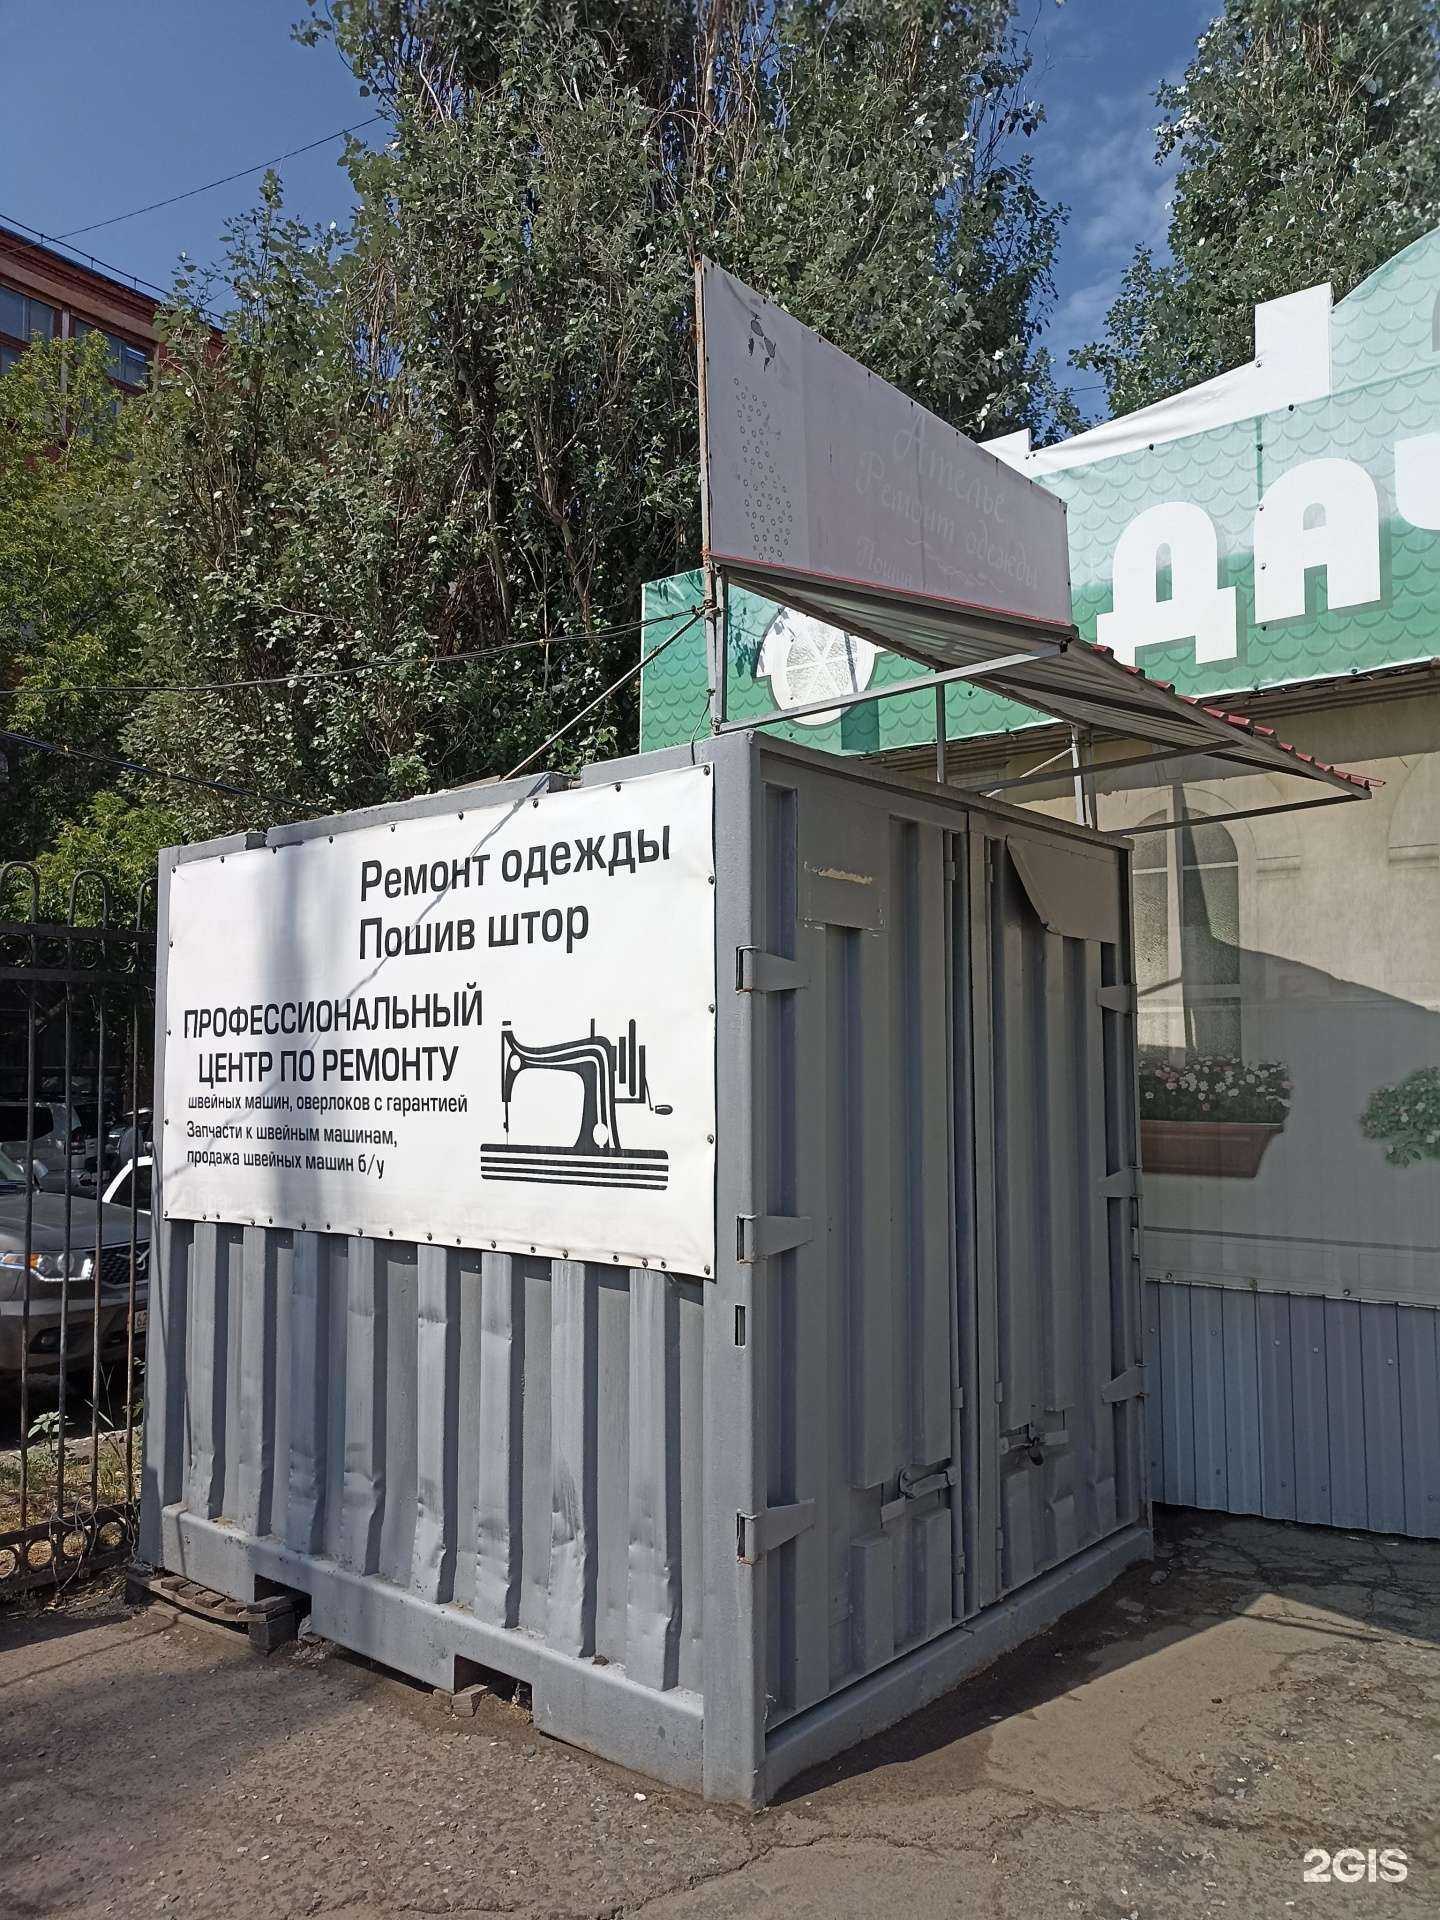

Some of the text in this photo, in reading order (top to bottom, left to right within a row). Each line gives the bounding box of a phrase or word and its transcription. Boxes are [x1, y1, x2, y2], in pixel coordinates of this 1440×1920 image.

[360, 825, 671, 902] Ремонт одежды
[359, 904, 589, 960] Пошив штор
[184, 982, 483, 1039] ПРОФЕССИОНАЛЬНЫЙ
[199, 1046, 459, 1089] ЦЕНТР ПО РЕМОНТУ
[188, 1093, 468, 1117] швейных машин, оверлоков с гарантией
[186, 1121, 398, 1148] Запчасти к швейным машинам,
[187, 1149, 385, 1179] продажа швейных машин б/у
